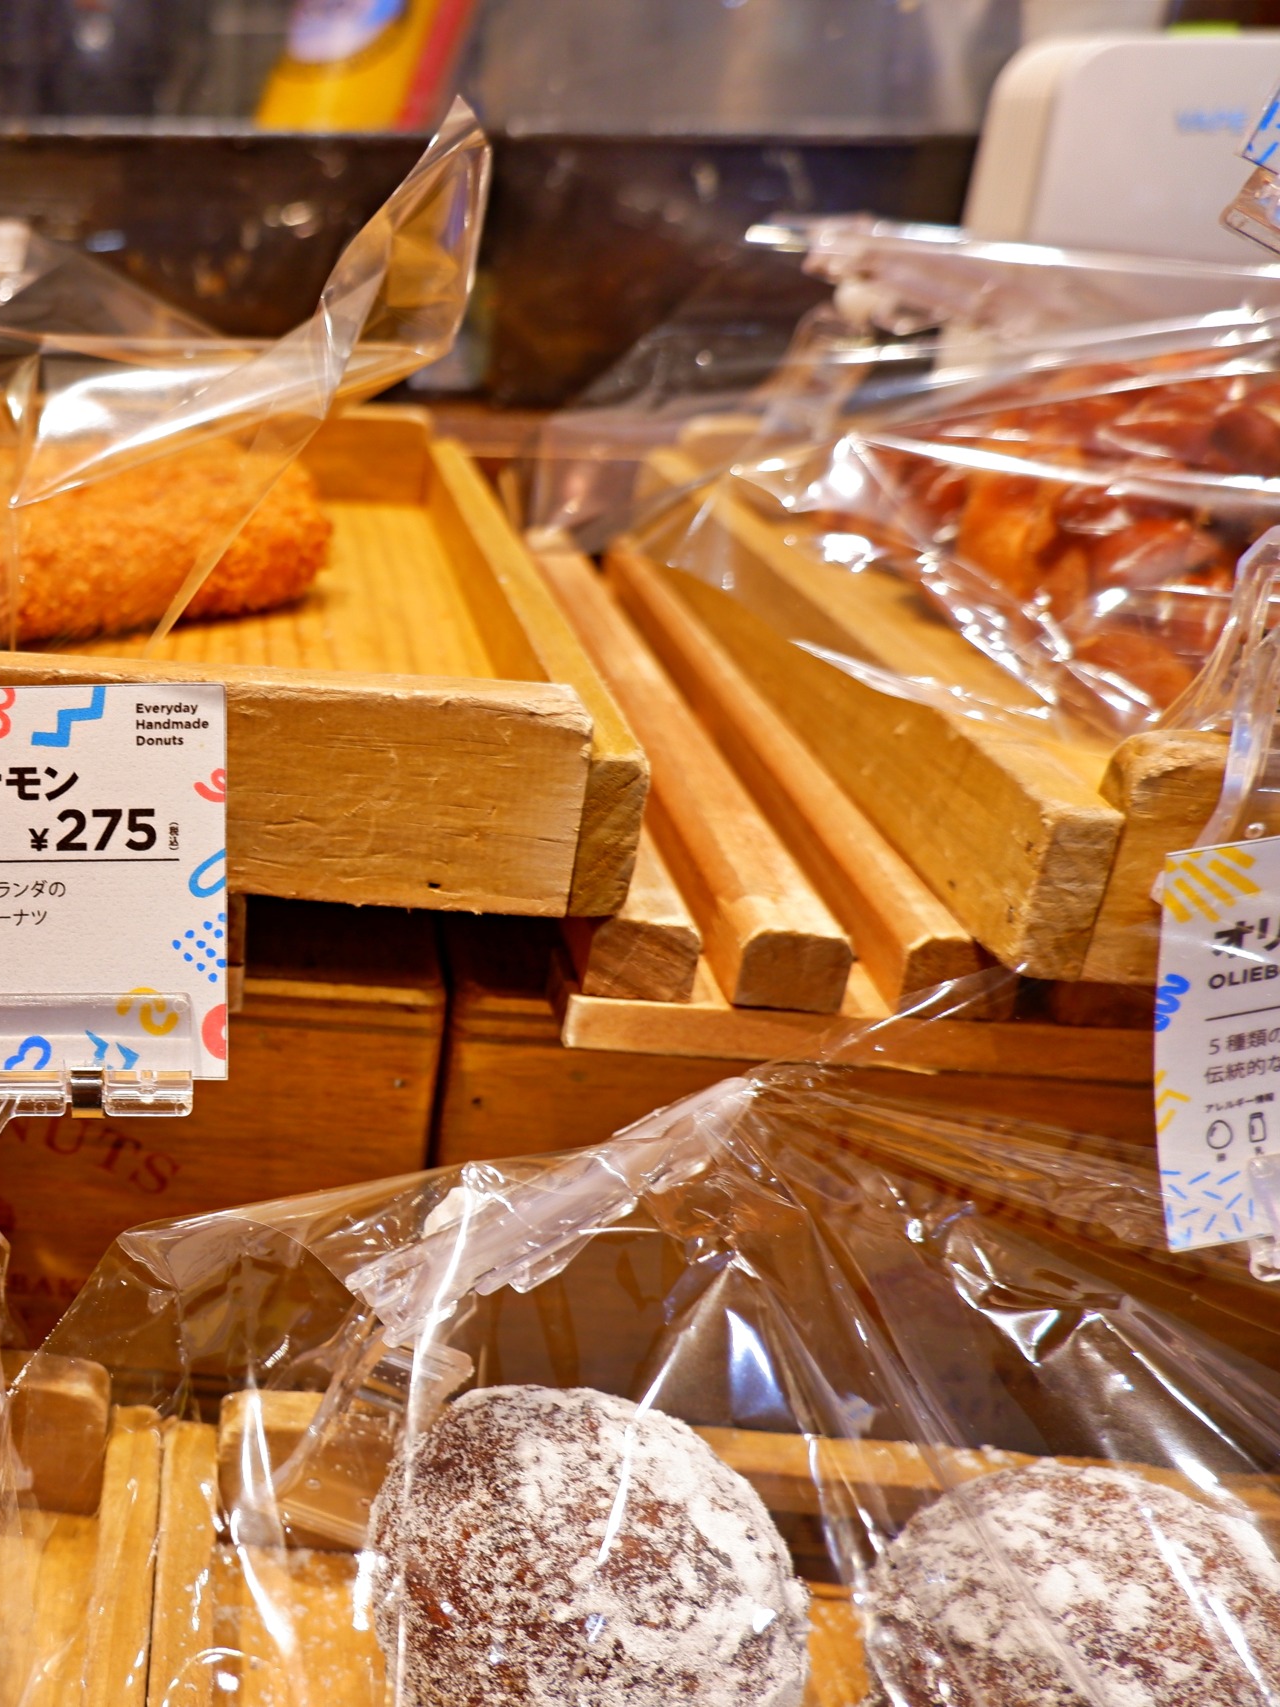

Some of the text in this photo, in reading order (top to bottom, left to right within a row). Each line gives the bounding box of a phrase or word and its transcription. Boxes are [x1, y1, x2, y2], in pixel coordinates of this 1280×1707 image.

[135, 703, 199, 718] Everyday
[135, 718, 209, 731] Handmade
[135, 734, 184, 746] Donuts
[28, 808, 157, 852] ¥275
